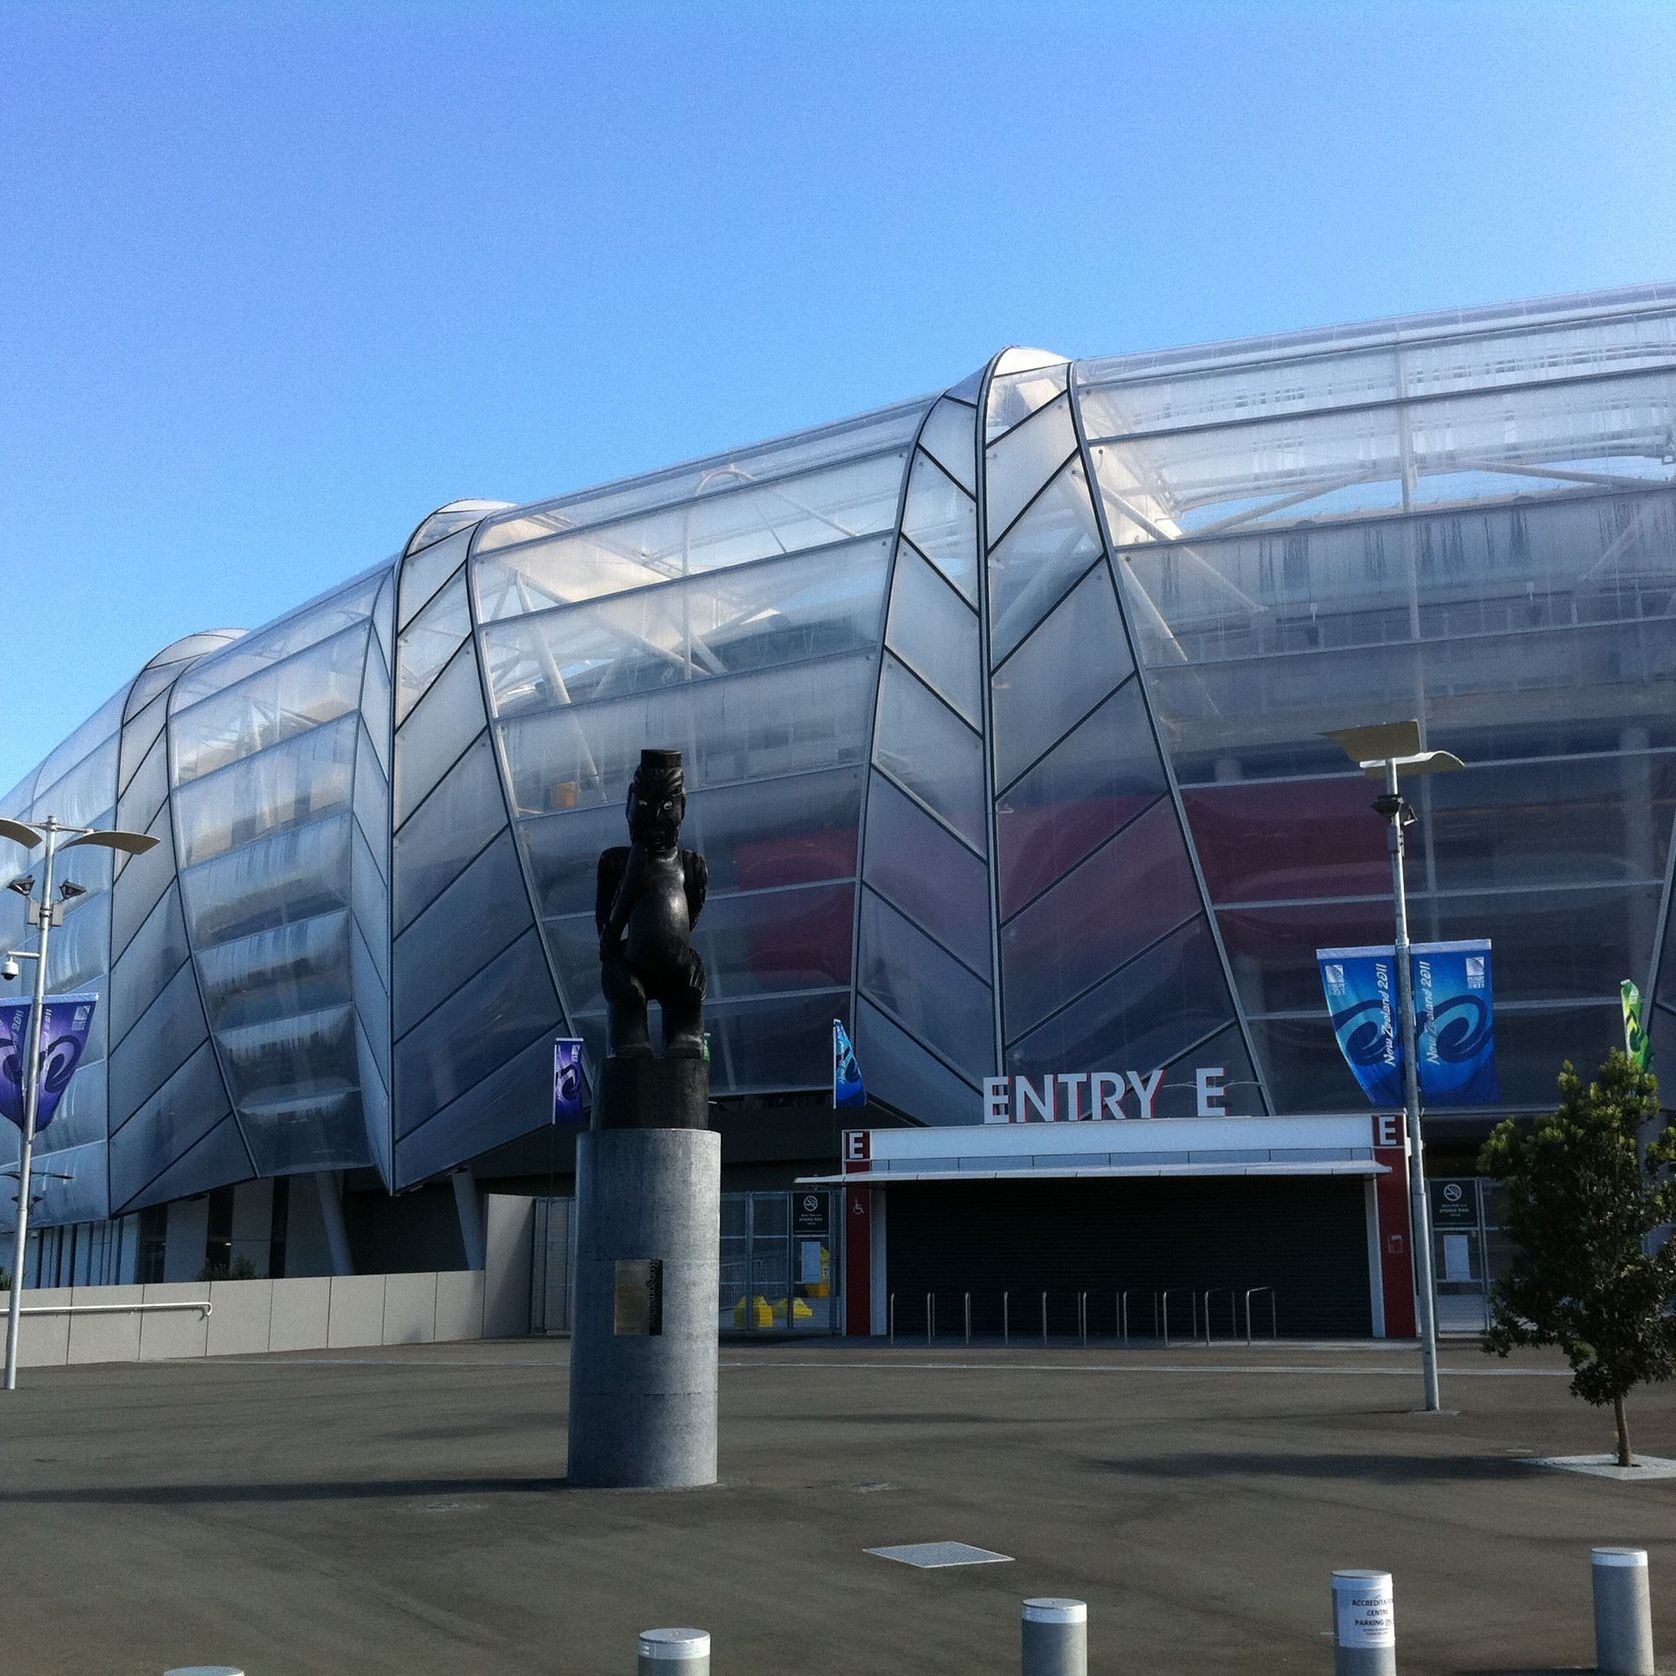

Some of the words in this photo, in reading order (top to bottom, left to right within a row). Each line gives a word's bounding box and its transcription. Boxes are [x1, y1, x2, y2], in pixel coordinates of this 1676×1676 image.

[1376, 963, 1389, 989] 2011
[1419, 960, 1432, 987] 2011
[1379, 990, 1394, 1038] Zealand
[1421, 988, 1437, 1036] Zealand
[1384, 1037, 1396, 1067] New
[983, 1070, 1165, 1124] ENTRY
[1196, 1068, 1226, 1117] E
[849, 1132, 863, 1158] E
[1379, 1116, 1396, 1145] E
